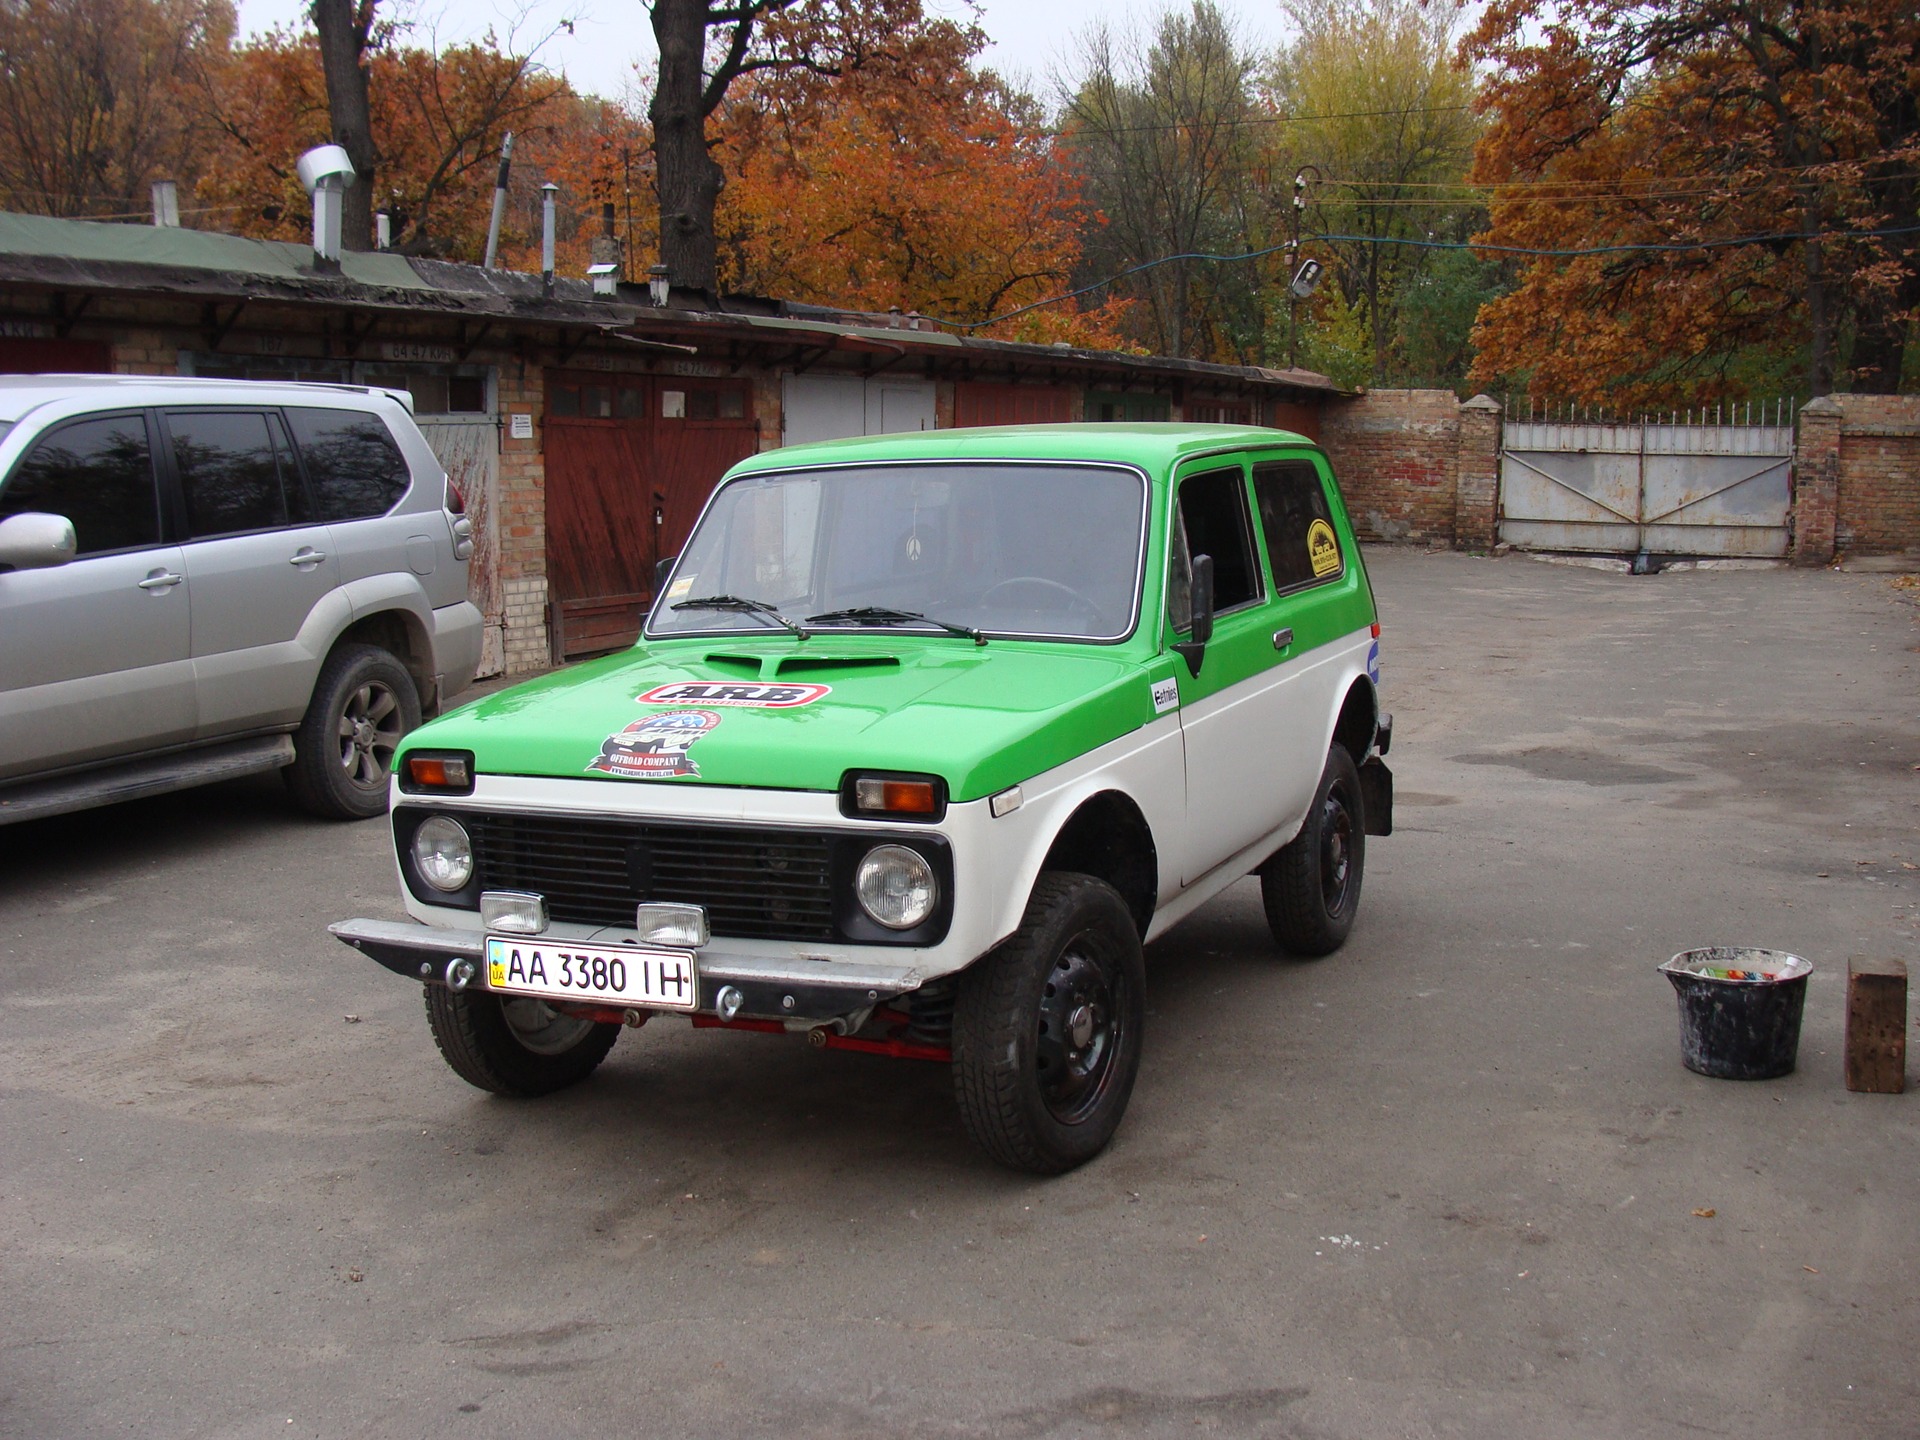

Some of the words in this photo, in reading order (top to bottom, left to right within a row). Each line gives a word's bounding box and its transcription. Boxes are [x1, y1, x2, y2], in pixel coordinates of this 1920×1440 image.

[657, 685, 806, 702] ARB
[610, 754, 643, 765] OFFROAD
[643, 756, 680, 766] COMPANY
[492, 971, 505, 980] UA
[508, 949, 549, 986] AA
[557, 953, 627, 992] 3380
[643, 960, 683, 997] IH
